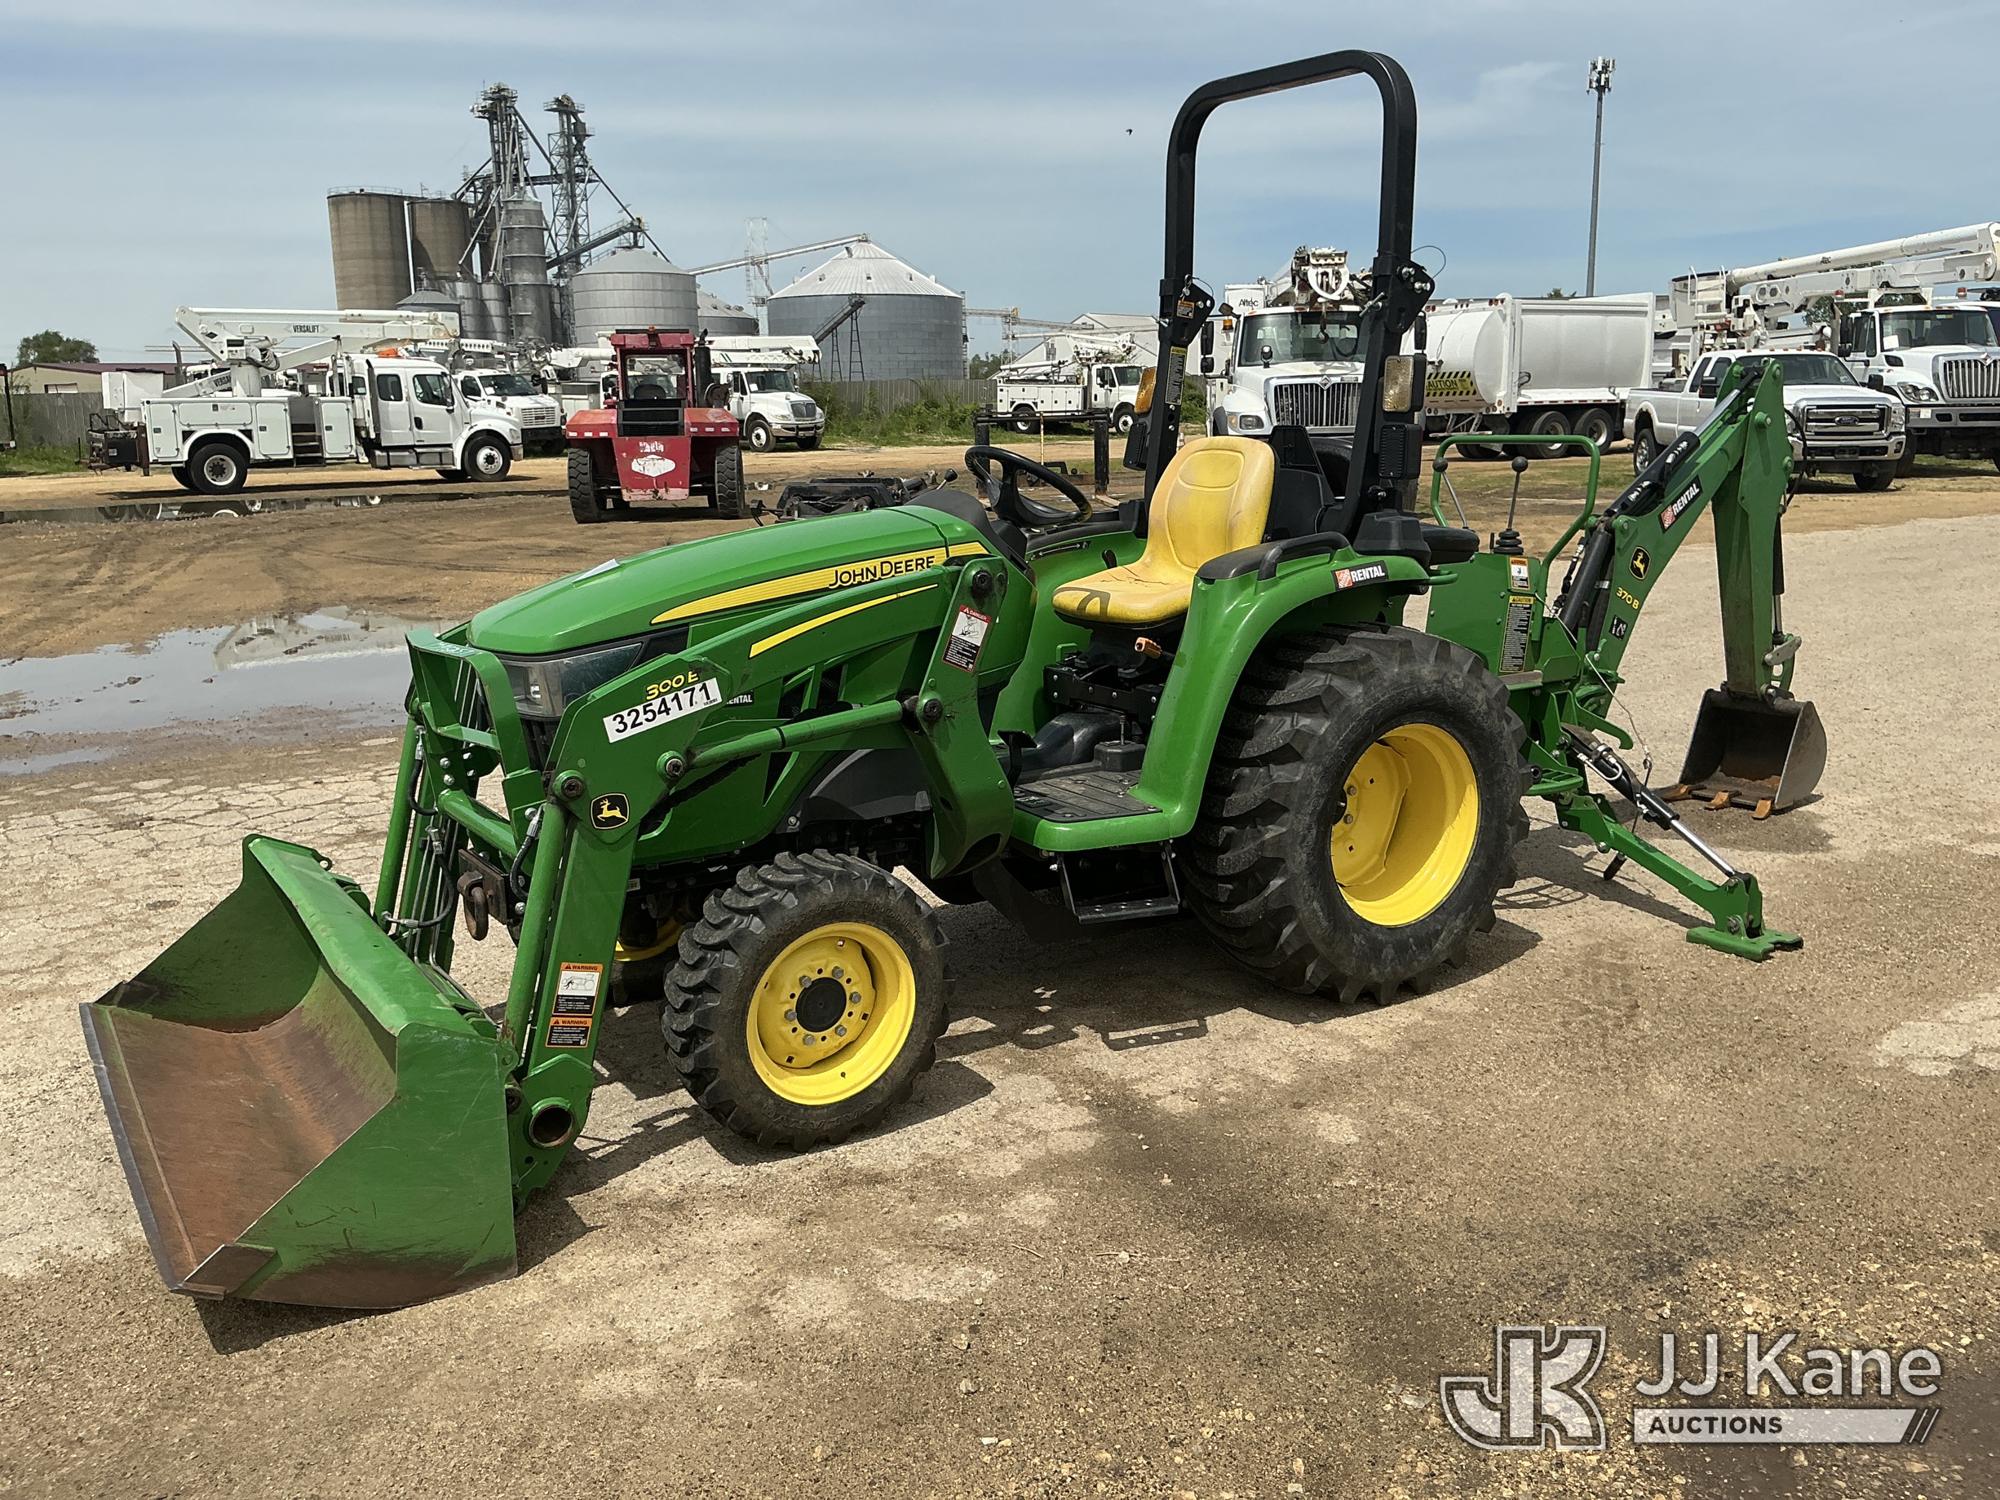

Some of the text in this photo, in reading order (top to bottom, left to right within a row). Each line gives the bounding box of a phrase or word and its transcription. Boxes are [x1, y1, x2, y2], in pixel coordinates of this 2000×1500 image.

[292, 324, 320, 333] VERSALIFT
[1426, 379, 1459, 389] AUTION
[1672, 483, 1700, 515] RENTAL
[828, 555, 935, 587] JOHN DEERE
[1350, 565, 1386, 582] RENTAL
[612, 682, 712, 734] 3254171
[726, 694, 753, 705] ENTAL
